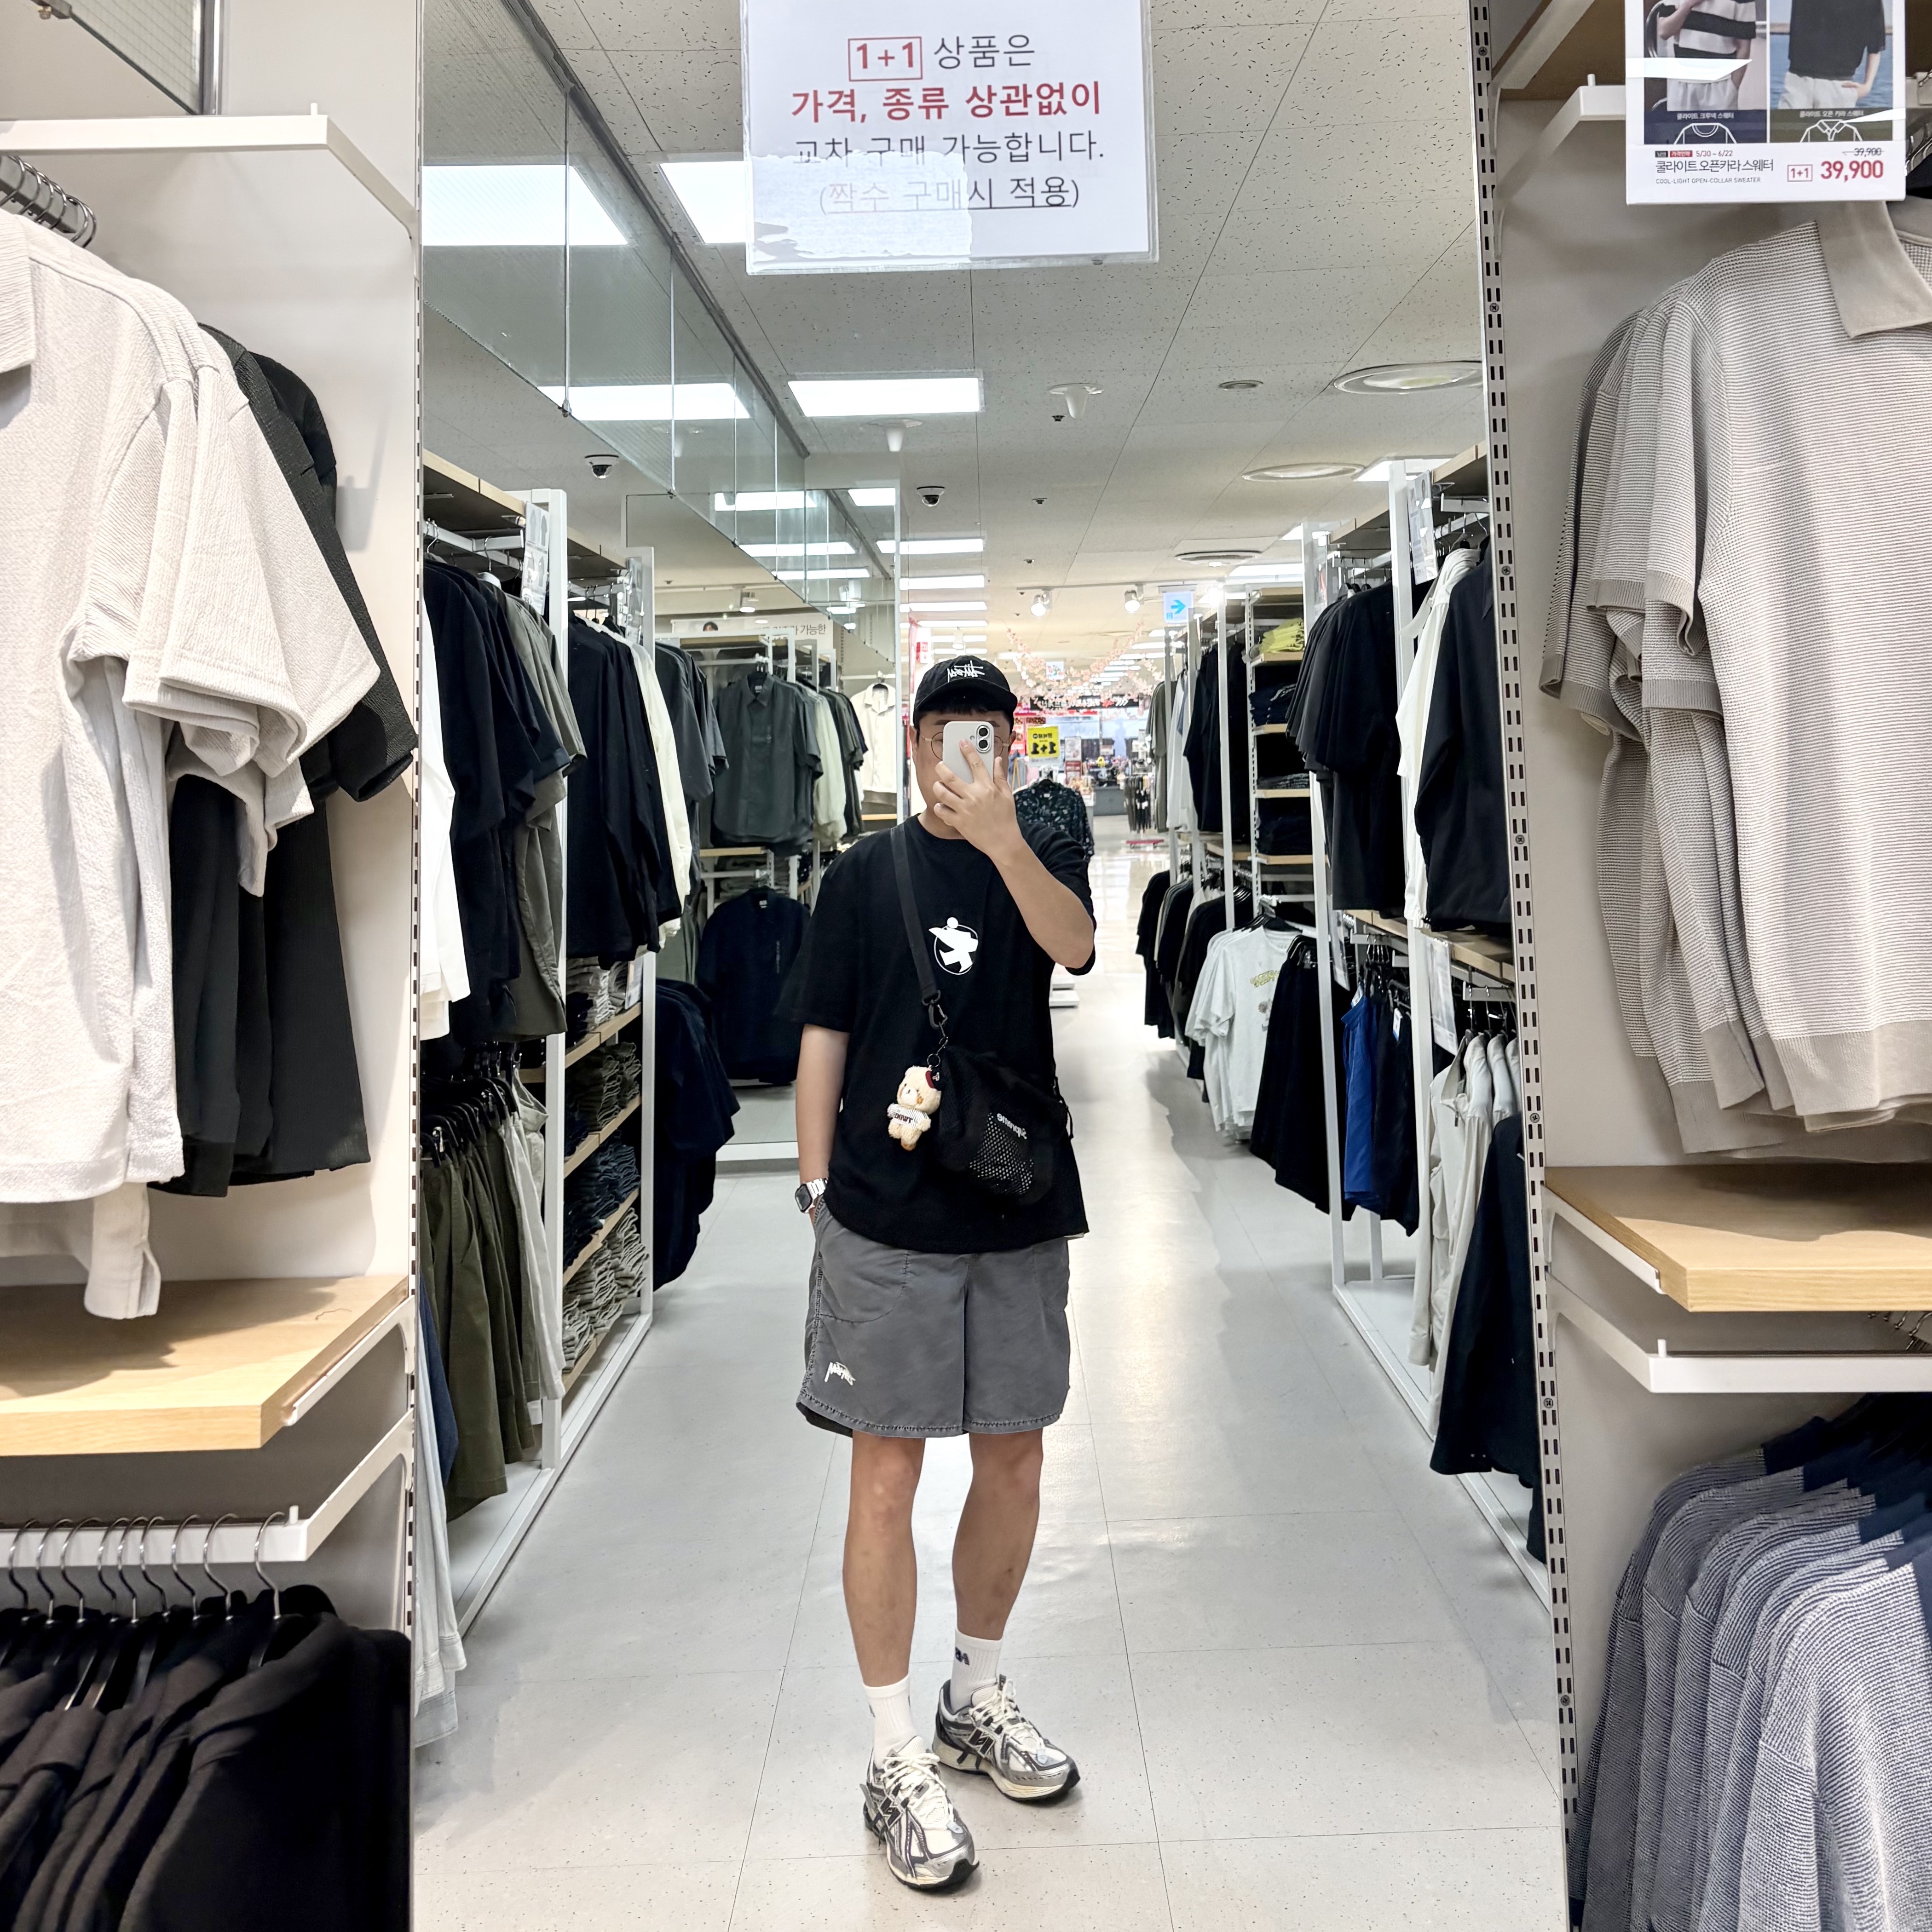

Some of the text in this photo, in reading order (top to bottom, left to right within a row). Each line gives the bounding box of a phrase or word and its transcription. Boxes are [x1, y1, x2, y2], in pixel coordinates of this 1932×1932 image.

[856, 34, 1035, 70] 1+1 상품은
[791, 81, 1100, 123] 가격, 종류 상관없이
[793, 130, 1104, 167] 교차 구매 가능합니다.
[1854, 147, 1882, 157] 39,900
[1655, 160, 1698, 173] 쿨라이트
[1742, 159, 1774, 172] 스웨터
[1790, 167, 1809, 179] 1+1
[1820, 160, 1884, 182] 39,900
[819, 182, 889, 215] (짝수
[1010, 177, 1079, 209] 적용)
[800, 624, 826, 635] 가능한
